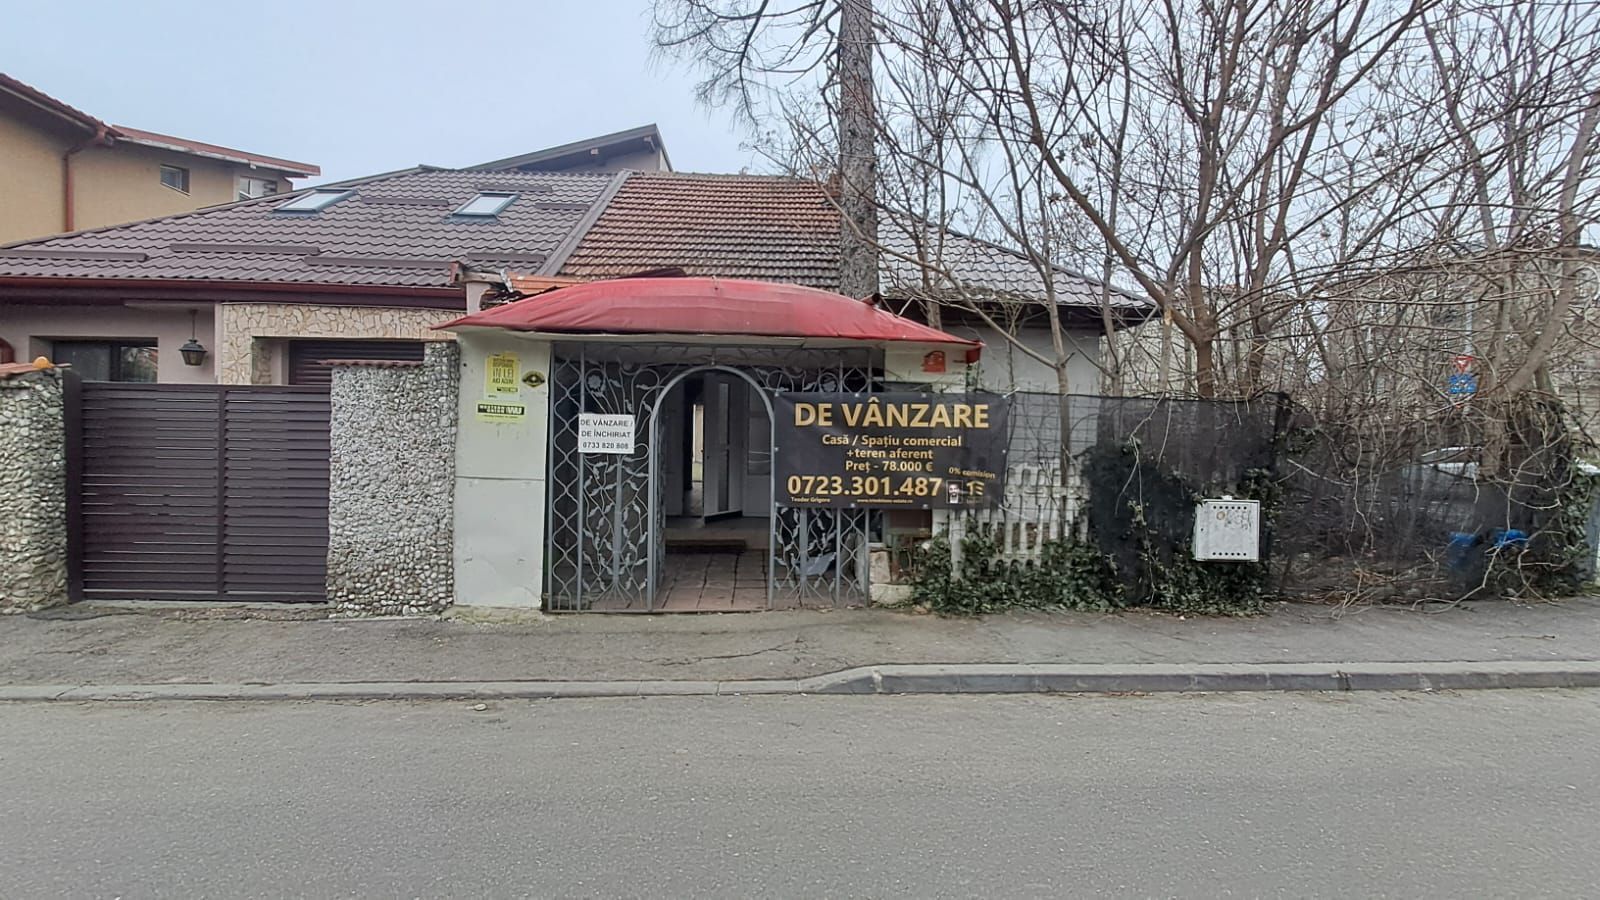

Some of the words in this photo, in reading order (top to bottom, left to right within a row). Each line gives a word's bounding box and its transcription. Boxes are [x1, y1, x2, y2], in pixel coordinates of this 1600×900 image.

[795, 403, 832, 426] DE
[841, 397, 990, 428] VÂNZARE
[593, 418, 629, 427] VÂNZARE
[594, 428, 631, 438] ÎNCHIRIAT
[822, 434, 849, 445] Casă
[852, 434, 858, 446] /
[902, 436, 962, 446] comercial
[847, 449, 886, 458] +teren
[889, 448, 933, 459] aferent
[882, 461, 922, 472] 78.000
[926, 462, 933, 472] €
[949, 466, 961, 474] 0%
[963, 470, 996, 479] comision
[788, 475, 943, 496] 0723.301.487
